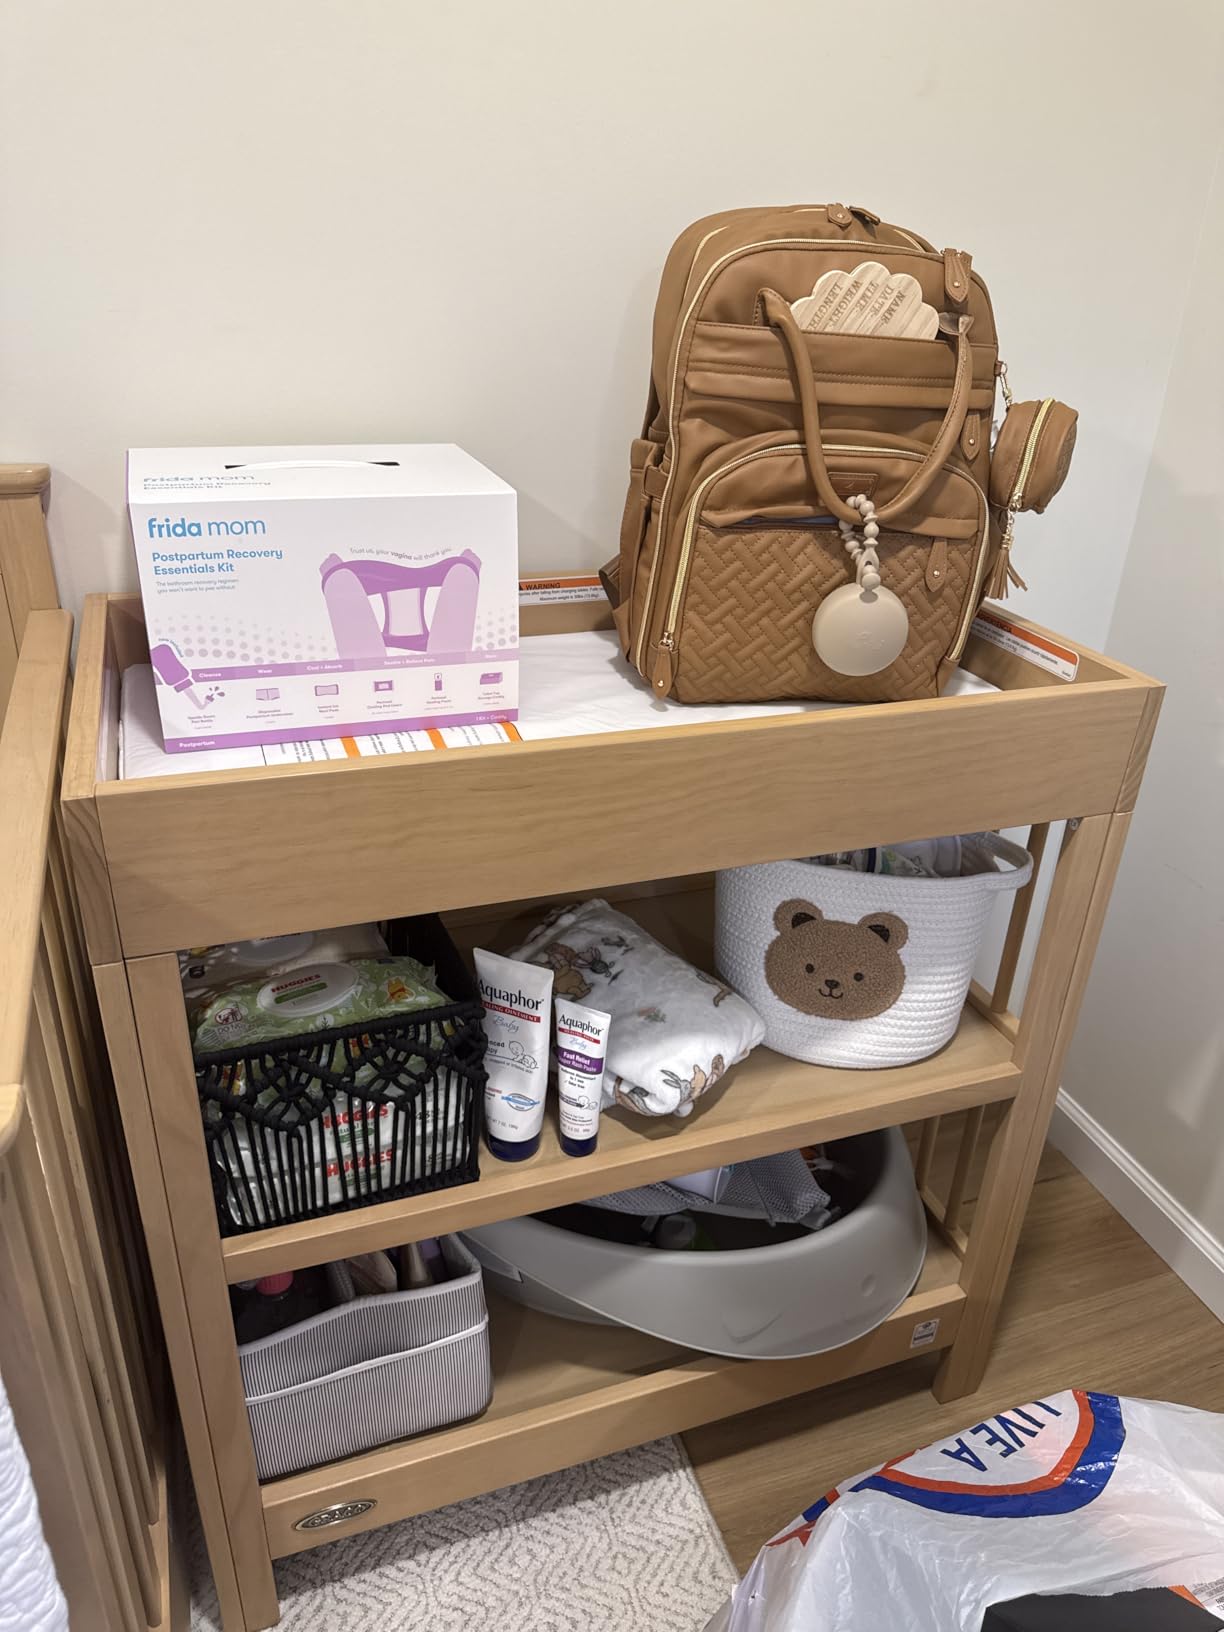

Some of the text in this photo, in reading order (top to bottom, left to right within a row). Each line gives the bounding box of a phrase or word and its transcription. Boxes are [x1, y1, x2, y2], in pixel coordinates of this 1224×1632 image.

[148, 518, 266, 538] frida mom
[152, 549, 283, 564] Postpartum Recovery
[391, 551, 412, 560] vagina
[154, 562, 234, 576] Essentials Kit
[525, 582, 561, 591] WARNING
[271, 974, 321, 993] HUGGIES
[504, 1009, 538, 1022] OINTMENT
[559, 1014, 602, 1036] Aquaphor
[489, 1040, 505, 1048] nced
[563, 1051, 590, 1065] Fast Relief
[940, 1437, 988, 1472] A
